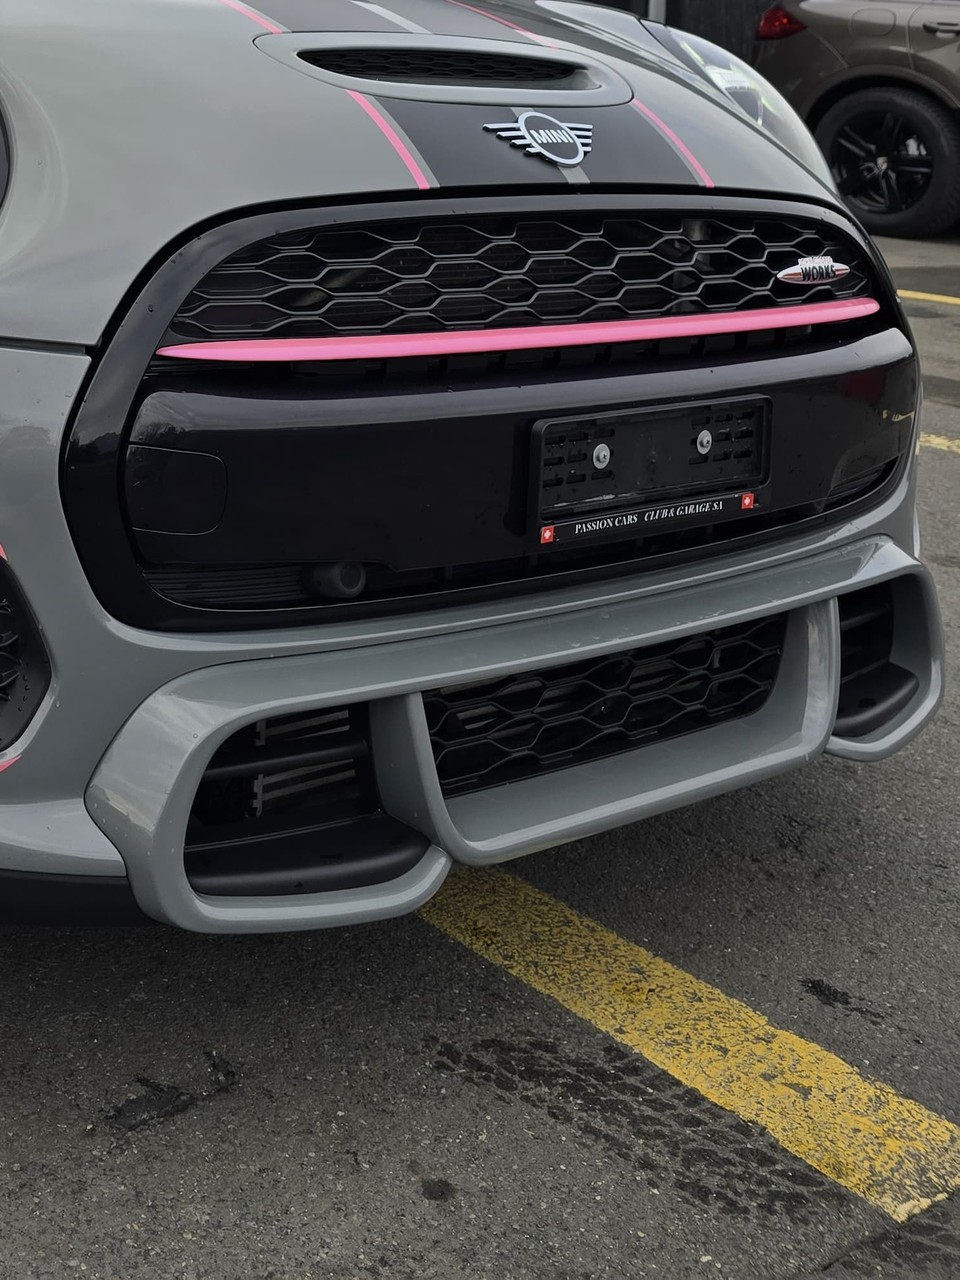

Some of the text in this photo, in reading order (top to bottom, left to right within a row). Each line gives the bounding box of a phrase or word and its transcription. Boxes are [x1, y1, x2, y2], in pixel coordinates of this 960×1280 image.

[529, 129, 574, 144] MINI
[801, 265, 836, 281] WORKS
[575, 518, 614, 534] PASSION
[614, 514, 638, 527] CARS
[676, 501, 711, 516] GARAGE
[712, 501, 723, 511] SA
